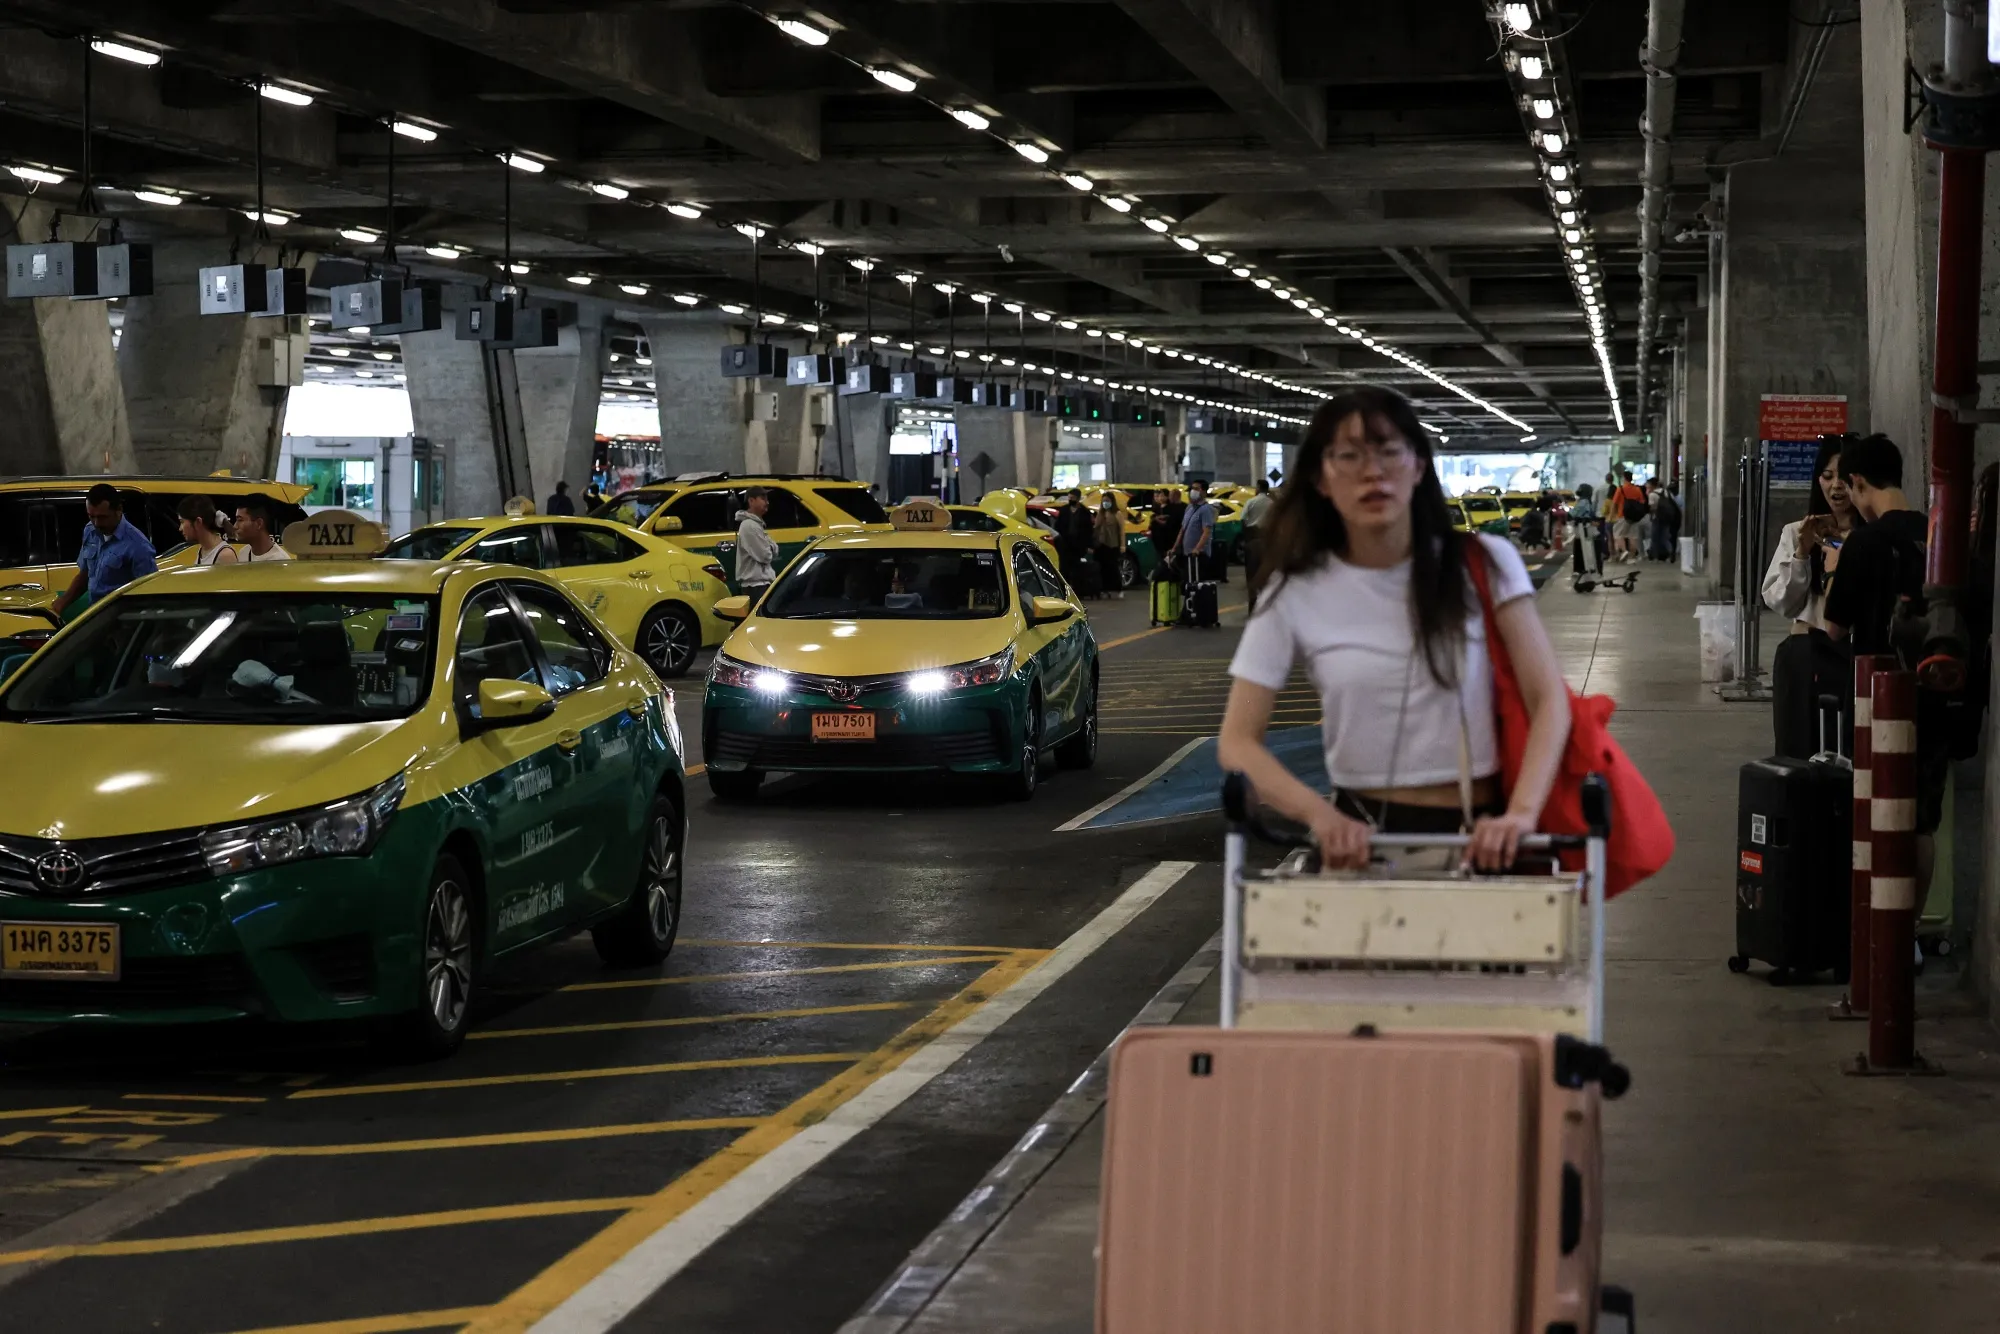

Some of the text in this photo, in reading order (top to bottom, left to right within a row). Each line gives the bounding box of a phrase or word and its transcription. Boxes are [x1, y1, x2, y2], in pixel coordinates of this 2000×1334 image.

[906, 510, 934, 522] TAXI
[308, 524, 355, 545] TAXI
[816, 715, 871, 727] 1มข 7501
[1741, 852, 1761, 870] Supreme
[10, 930, 111, 953] 1มค 3375
